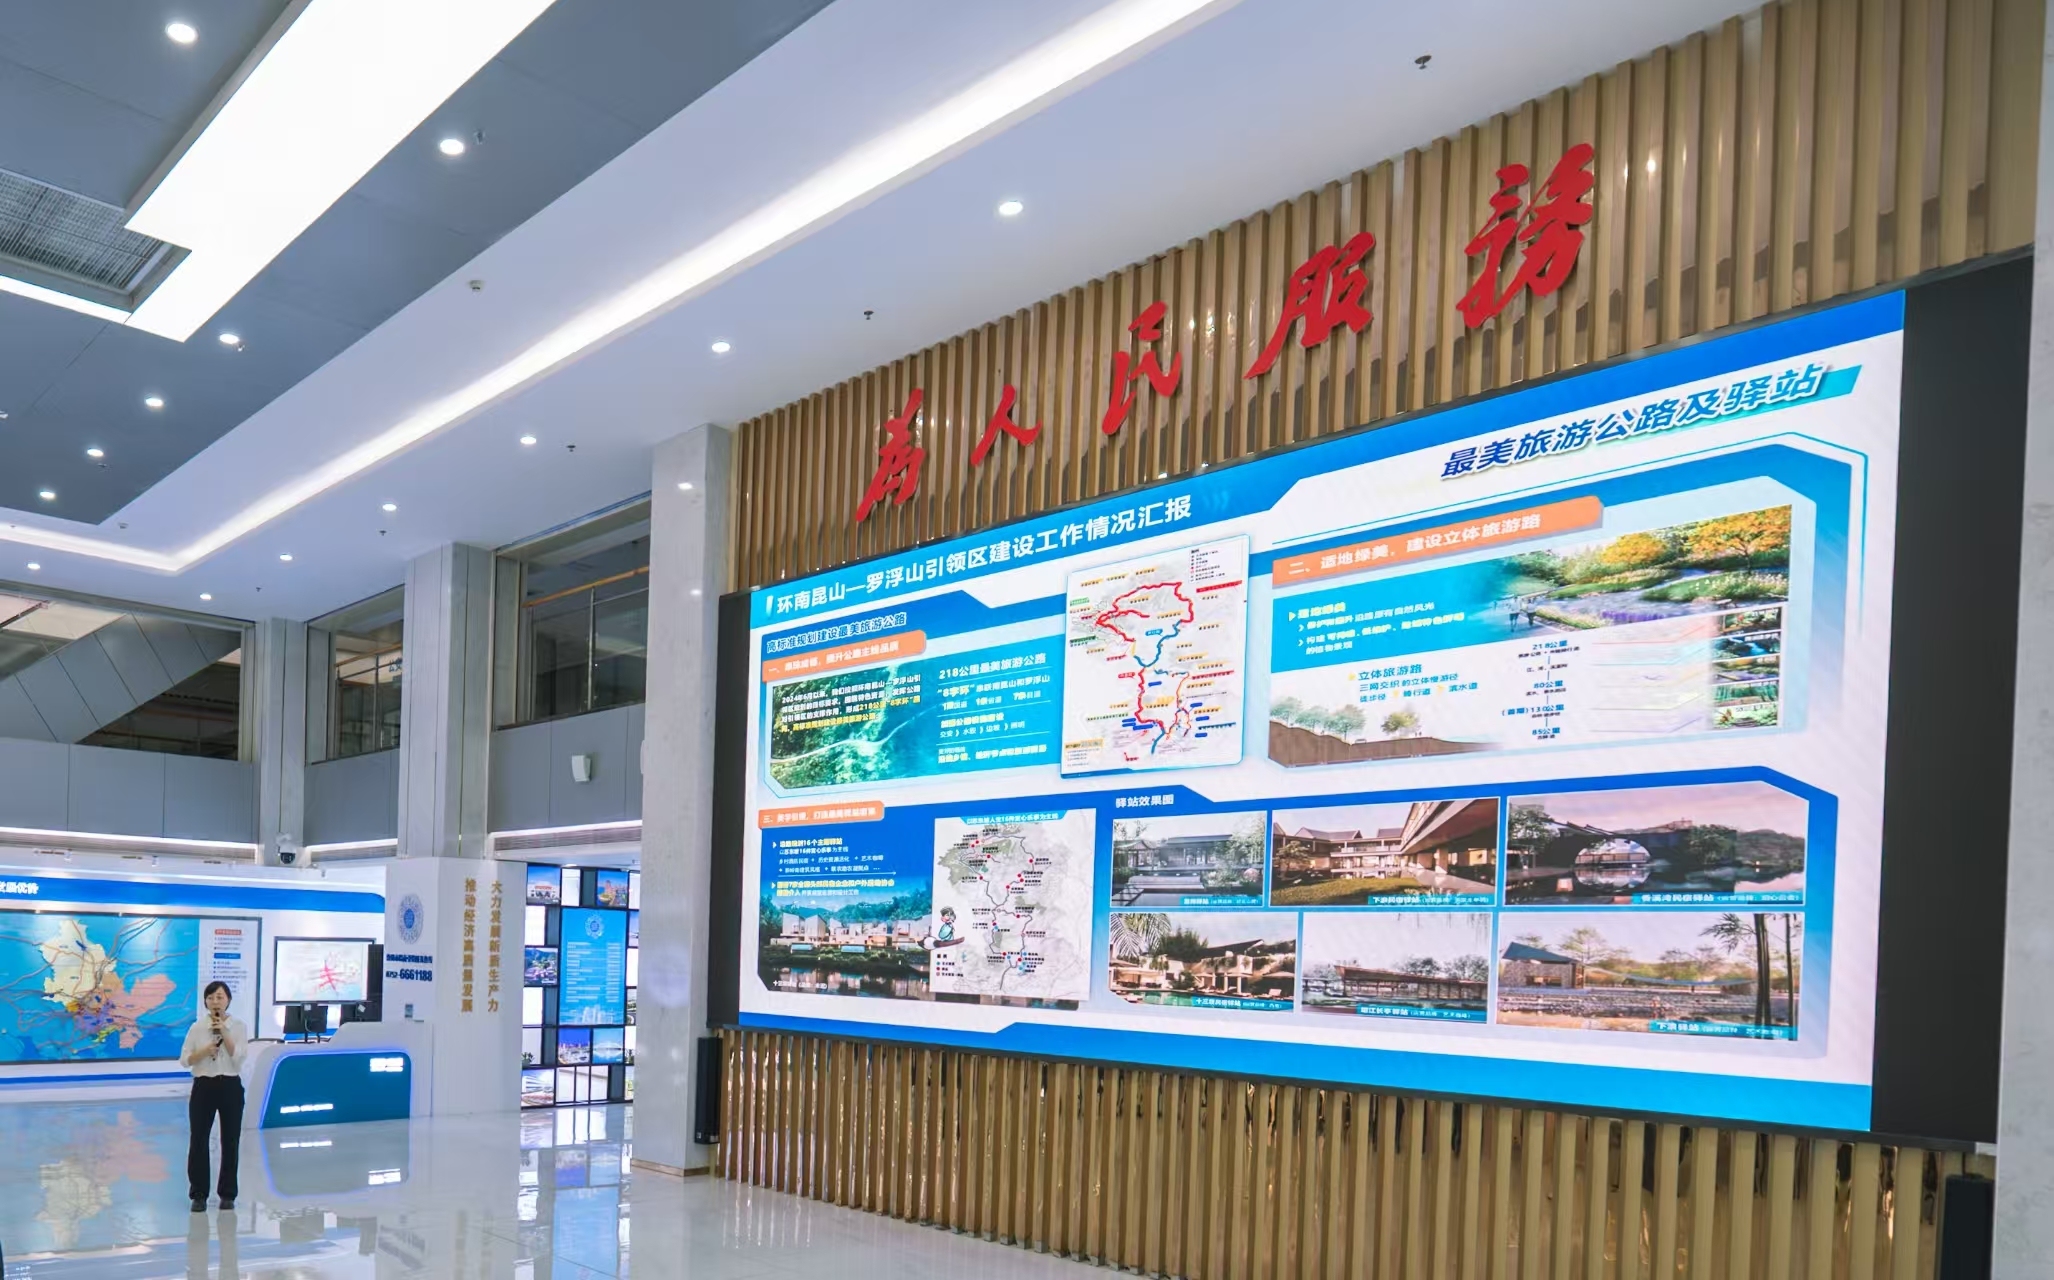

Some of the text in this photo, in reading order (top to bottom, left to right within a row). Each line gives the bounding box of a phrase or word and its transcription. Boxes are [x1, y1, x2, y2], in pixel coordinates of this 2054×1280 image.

[1441, 363, 1825, 480] 最美旅游公路及驿站
[777, 494, 1192, 614] 环南昆山—罗浮山引领区建设工作情况汇报
[767, 611, 907, 653] 高标准规划建设最美旅游公路
[939, 653, 1046, 679] 218公里最美旅游公路
[1358, 664, 1422, 680] 立体旅游路
[1115, 794, 1174, 809] 驿站效果图
